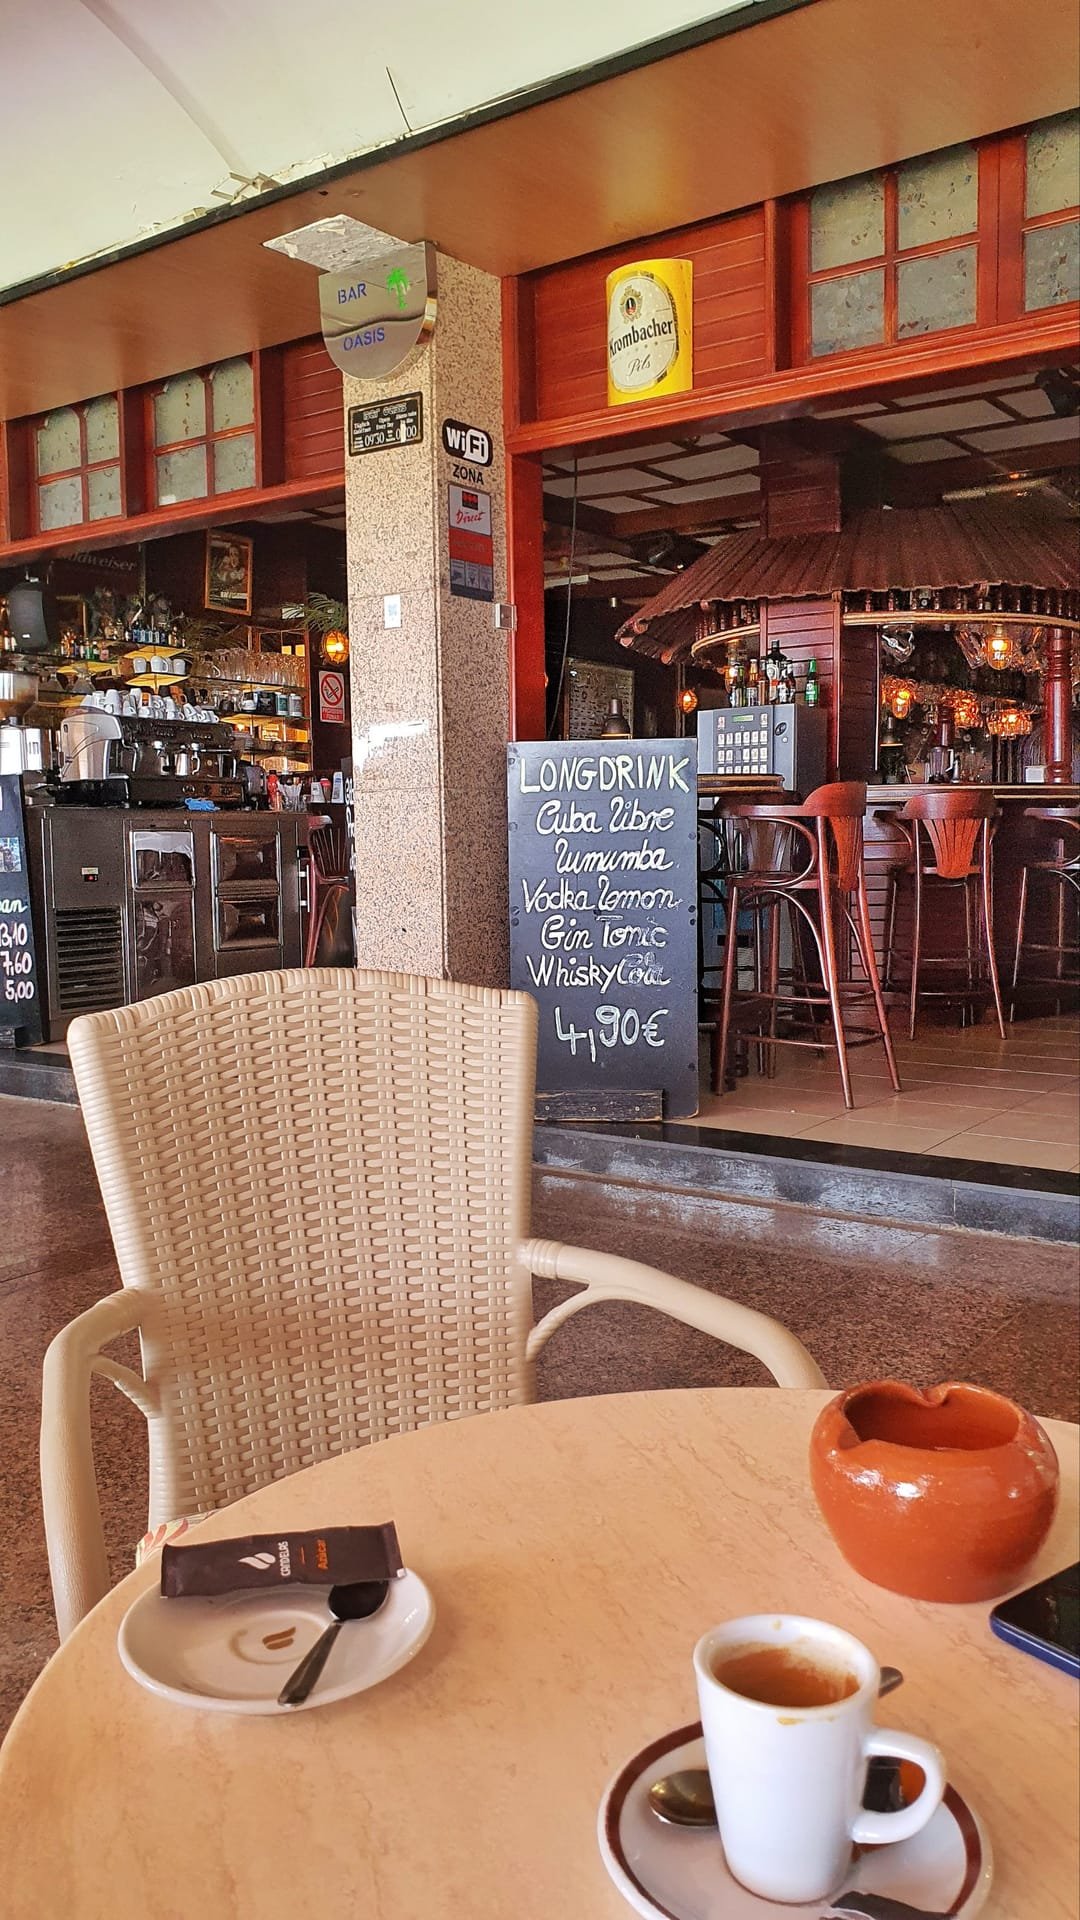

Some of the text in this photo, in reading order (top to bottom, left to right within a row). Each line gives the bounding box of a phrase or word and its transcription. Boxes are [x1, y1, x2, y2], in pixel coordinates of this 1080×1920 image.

[338, 283, 367, 304] BAR
[343, 327, 385, 351] OASIS
[627, 354, 651, 377] Pils
[453, 464, 485, 485] ZONA
[536, 796, 675, 835] Cuba Libre
[522, 878, 596, 913] Vodka
[541, 915, 669, 950] Gin Tonic
[0, 951, 32, 976] 7,60
[526, 954, 619, 993] Whisky
[5, 980, 34, 1003] 5,00
[555, 1004, 670, 1063] 4,90€
